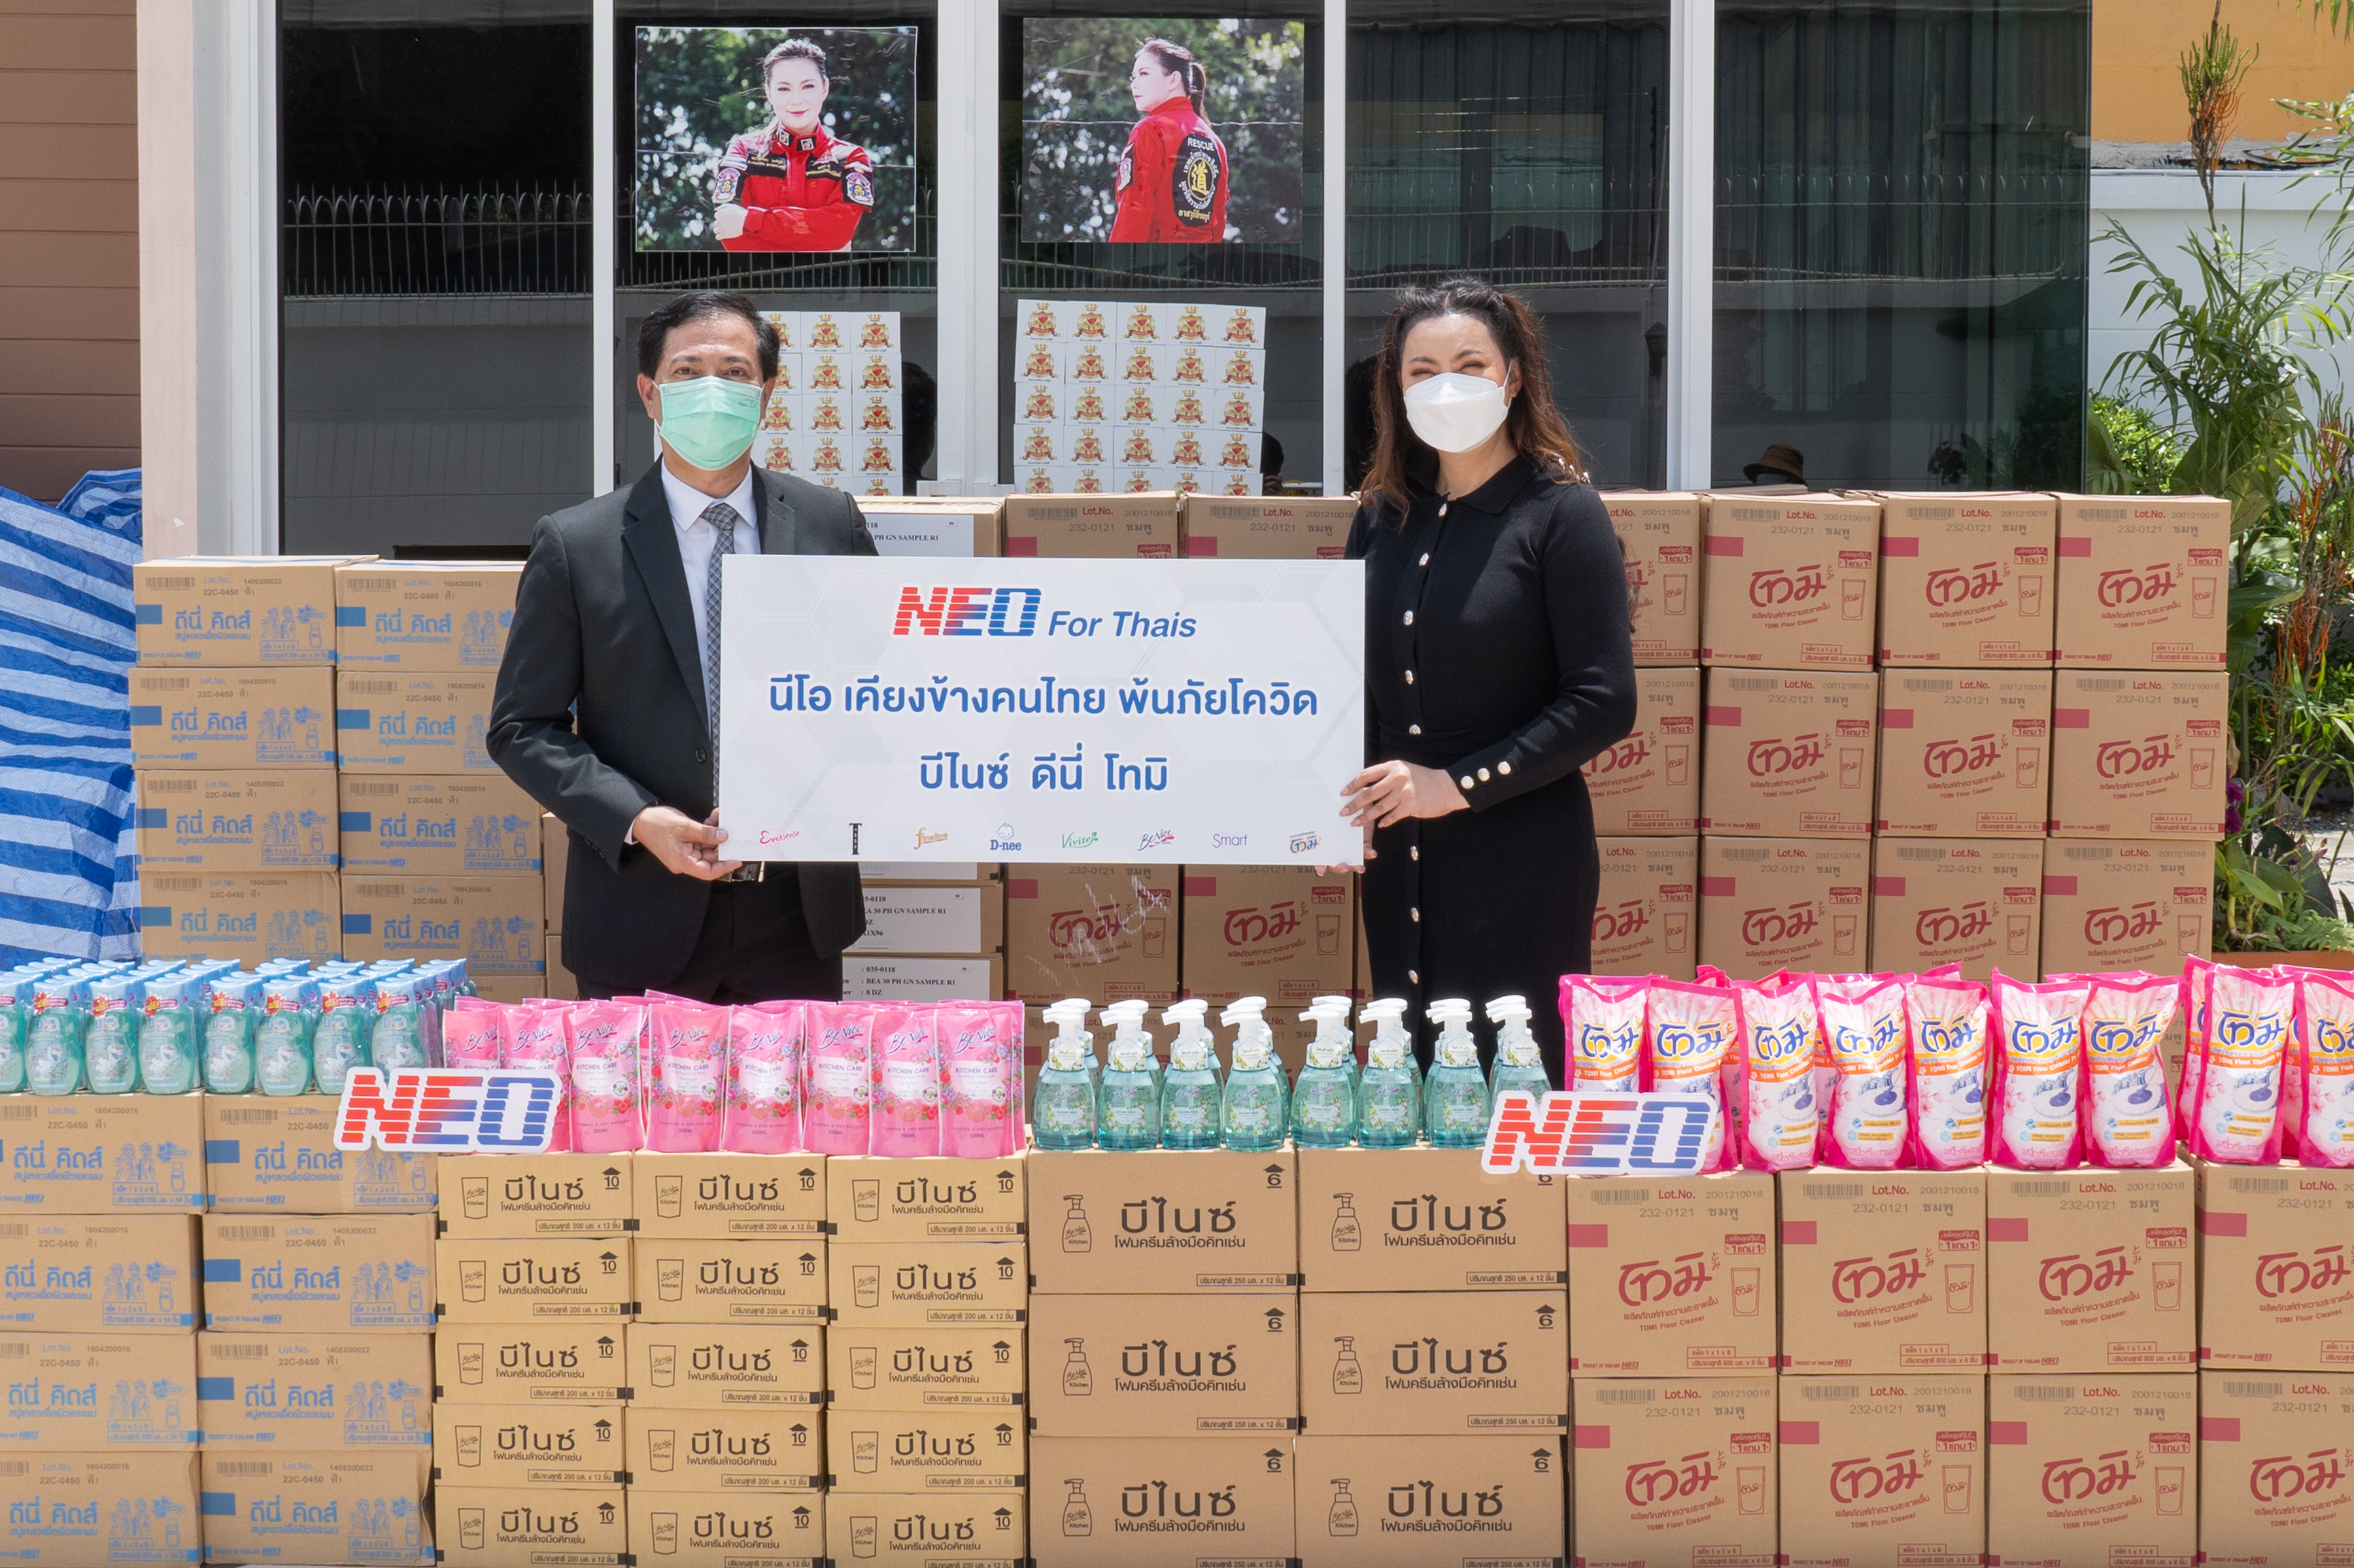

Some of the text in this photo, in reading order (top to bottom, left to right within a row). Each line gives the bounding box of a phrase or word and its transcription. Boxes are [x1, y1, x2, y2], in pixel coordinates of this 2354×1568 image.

[1187, 137, 1215, 151] RESCUE
[1082, 506, 1113, 516] Lot.No.
[1263, 507, 1294, 517] Lot.No.
[1786, 510, 1817, 520] Lot.No.
[2135, 509, 2166, 519] Lot.No.
[1070, 522, 1114, 533] 232-0121
[1770, 525, 1815, 536] 232-0121
[2117, 524, 2162, 535] 232-0121
[1749, 564, 1826, 608] โทมิ
[2098, 564, 2175, 607] โทมิ
[175, 605, 253, 630] ดีนี่ คิดส์
[375, 607, 453, 634] ดีนี่ คิดส์
[894, 588, 1196, 637] NEO For Thais
[771, 674, 1317, 715] นีโอ เคียงข้างคนไทย พ้นภัยโควิด
[1960, 680, 1990, 690] Lot.No.
[1944, 695, 1988, 706] 232-0121
[171, 706, 249, 732] ดีนี่ คิดส์
[921, 743, 1167, 791] บีไนซ์ ดีนี่ โทมิ
[1747, 733, 1824, 777] โทมิ
[1924, 734, 2001, 778] โทมิ
[380, 812, 458, 838] ดีนี่ คิดส์
[759, 830, 800, 844] Eversense
[989, 839, 1022, 851] D-nee
[1212, 833, 1248, 848] Smart
[2120, 847, 2151, 857] Lot.No.
[1223, 902, 1301, 946] โทมิ
[2085, 902, 2162, 946] โทมิ
[1657, 1023, 1726, 1057] โทมิ
[2012, 1015, 2078, 1053] โทมิ
[2090, 1014, 2160, 1053] โทมิ
[2218, 1011, 2285, 1046] โทมิ
[668, 1063, 693, 1071] KITCHEN
[340, 1075, 554, 1144] NEO
[1489, 1098, 1711, 1168] NEO
[14, 1140, 103, 1168] ดีนี่ คิดส์
[505, 1174, 584, 1201] บีไนซ์
[605, 1175, 619, 1187] 10
[700, 1174, 778, 1201] บีไนซ์
[898, 1177, 976, 1203] บีไนซ์
[998, 1178, 1013, 1191] 10
[1268, 1173, 1283, 1185] 6
[2079, 1182, 2117, 1193] Lot.No.
[1658, 1189, 1696, 1200] Lot.No.
[2060, 1200, 2115, 1210] 232-0121
[1121, 1197, 1236, 1233] บีไนซ์
[1391, 1195, 1506, 1231] บีไนซ์
[1639, 1207, 1694, 1218] 232-0121
[252, 1260, 340, 1289] ดีนี่ คิดส์
[1619, 1252, 1712, 1306] โทมิ
[1833, 1249, 1926, 1303] โทมิ
[2040, 1246, 2133, 1300] โทมิ
[2257, 1244, 2349, 1298] โทมิ
[1539, 1314, 1554, 1326] 6
[500, 1342, 579, 1368] บีไนซ์
[599, 1344, 613, 1356] 10
[895, 1346, 973, 1372] บีไนซ์
[1122, 1340, 1237, 1376] บีไนซ์
[1393, 1338, 1507, 1374] บีไนซ์
[1870, 1386, 1907, 1397] Lot.No.
[1849, 1404, 1903, 1414] 232-0121
[1268, 1457, 1283, 1470] 6
[1535, 1457, 1550, 1470] 6
[1830, 1450, 1923, 1503] โทมิ
[2251, 1448, 2344, 1502] โทมิ
[1121, 1480, 1236, 1517] บีไนซ์
[1388, 1480, 1503, 1517] บีไนซ์
[501, 1507, 579, 1533] บีไนซ์
[794, 1514, 809, 1526] 10
[895, 1514, 974, 1541] บีไนซ์
